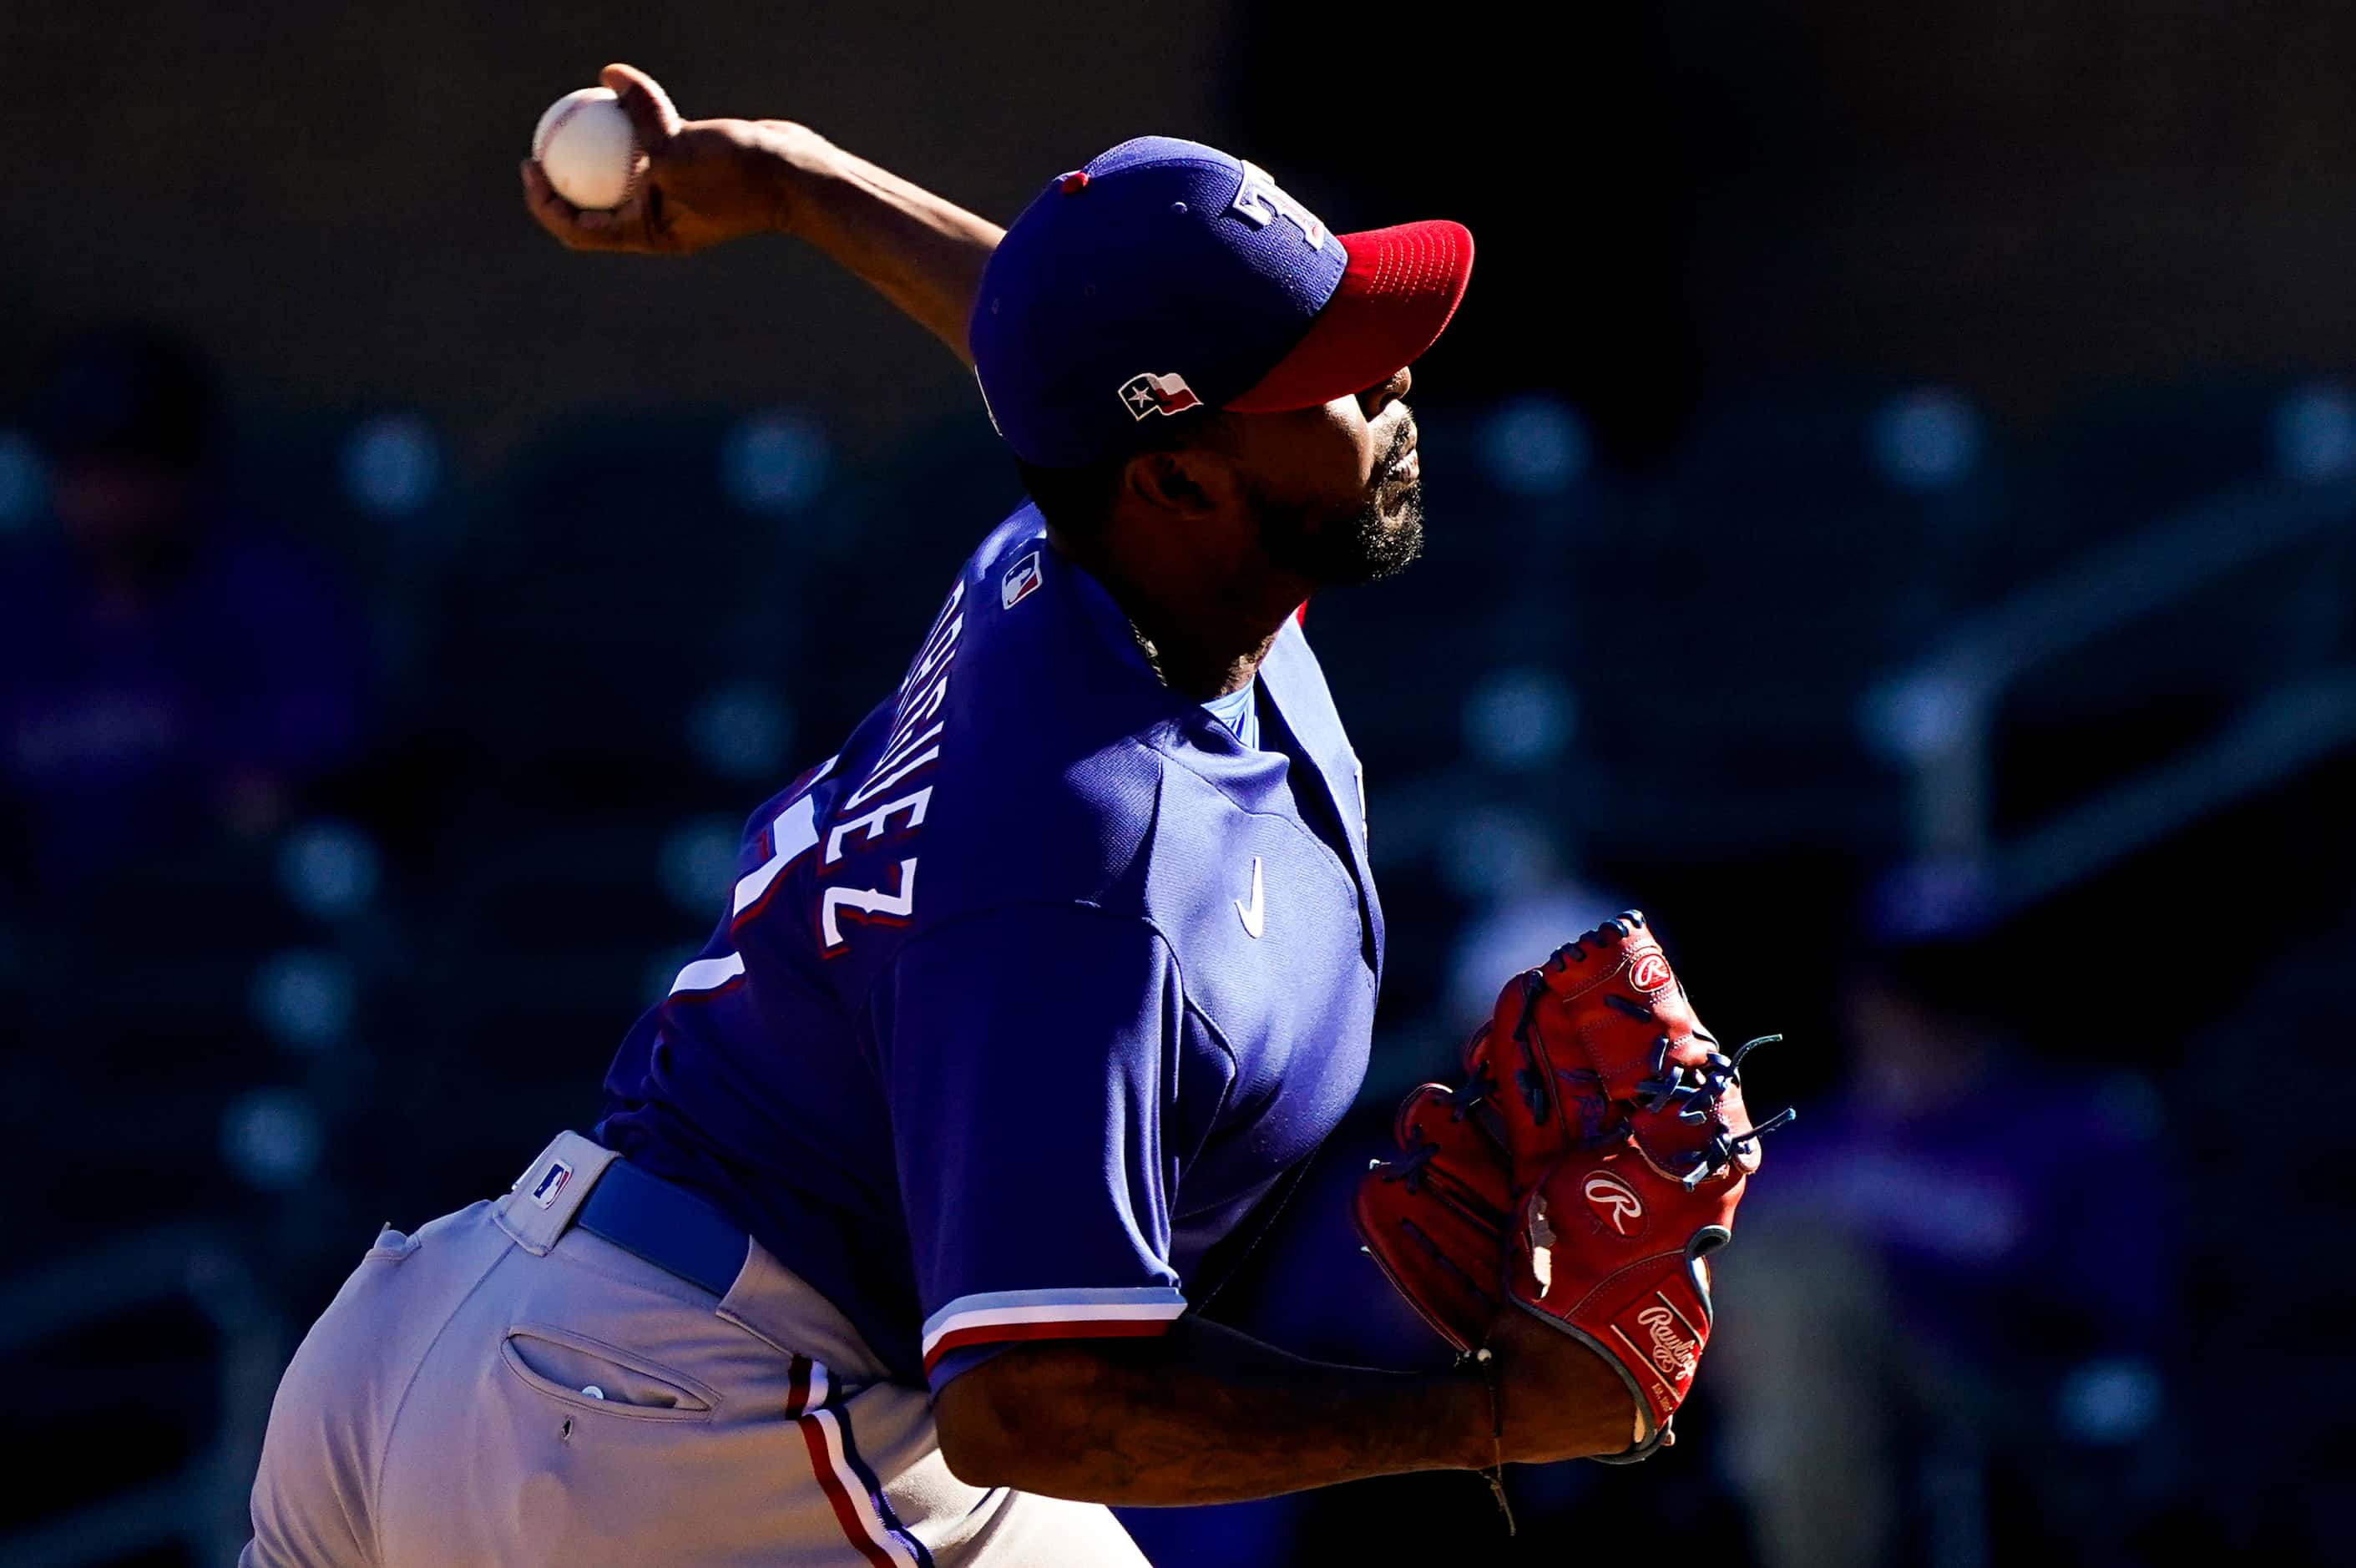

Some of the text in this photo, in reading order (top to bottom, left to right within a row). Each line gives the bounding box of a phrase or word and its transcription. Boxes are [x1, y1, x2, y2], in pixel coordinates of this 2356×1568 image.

[1232, 159, 1326, 251] T
[1635, 955, 1669, 988] R
[1585, 1178, 1641, 1235] R
[1637, 1306, 1697, 1381] Rawling
